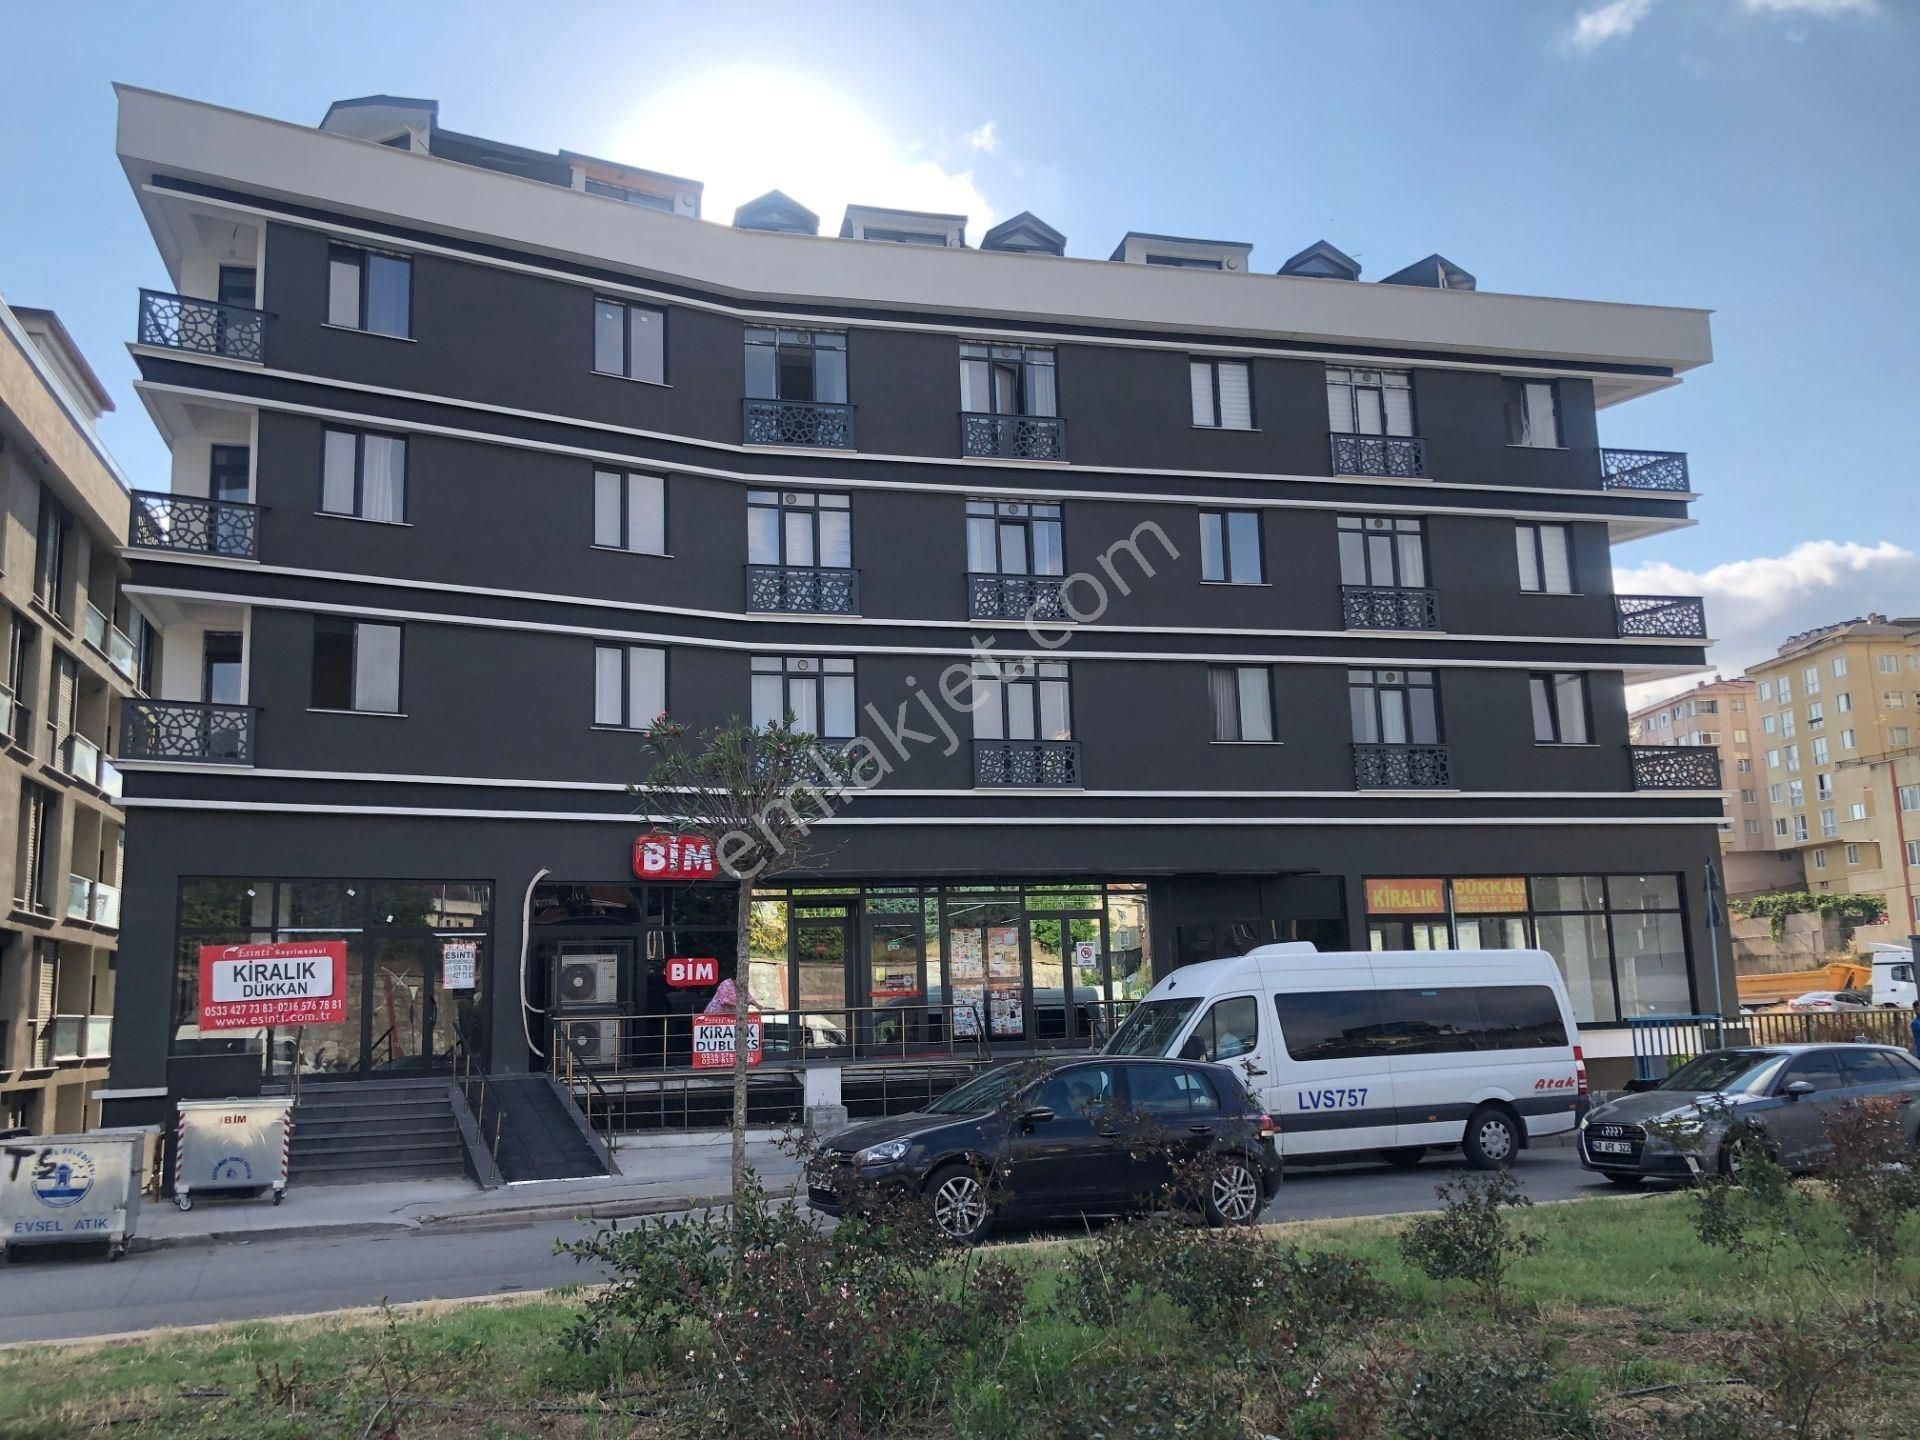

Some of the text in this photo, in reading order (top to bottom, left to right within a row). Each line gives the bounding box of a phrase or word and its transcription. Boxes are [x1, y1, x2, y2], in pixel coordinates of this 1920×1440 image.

[643, 836, 712, 872] BİM
[1373, 885, 1439, 908] KİRALIK
[233, 960, 316, 983] KİRALIK
[671, 958, 713, 981] BİM
[243, 981, 308, 998] DÜKKAN
[205, 1006, 228, 1017] 0533
[230, 1005, 246, 1015] 427
[249, 1004, 260, 1014] 73
[301, 1001, 317, 1010] 576
[319, 1000, 329, 1010] 78
[332, 999, 342, 1009] 81
[215, 1011, 331, 1026] www.esinti.com.tr
[1535, 1077, 1575, 1090] Atak
[1298, 1088, 1369, 1111] LVS757
[224, 1114, 247, 1124] BİM
[14, 1218, 108, 1233] EVSEL ATIK
